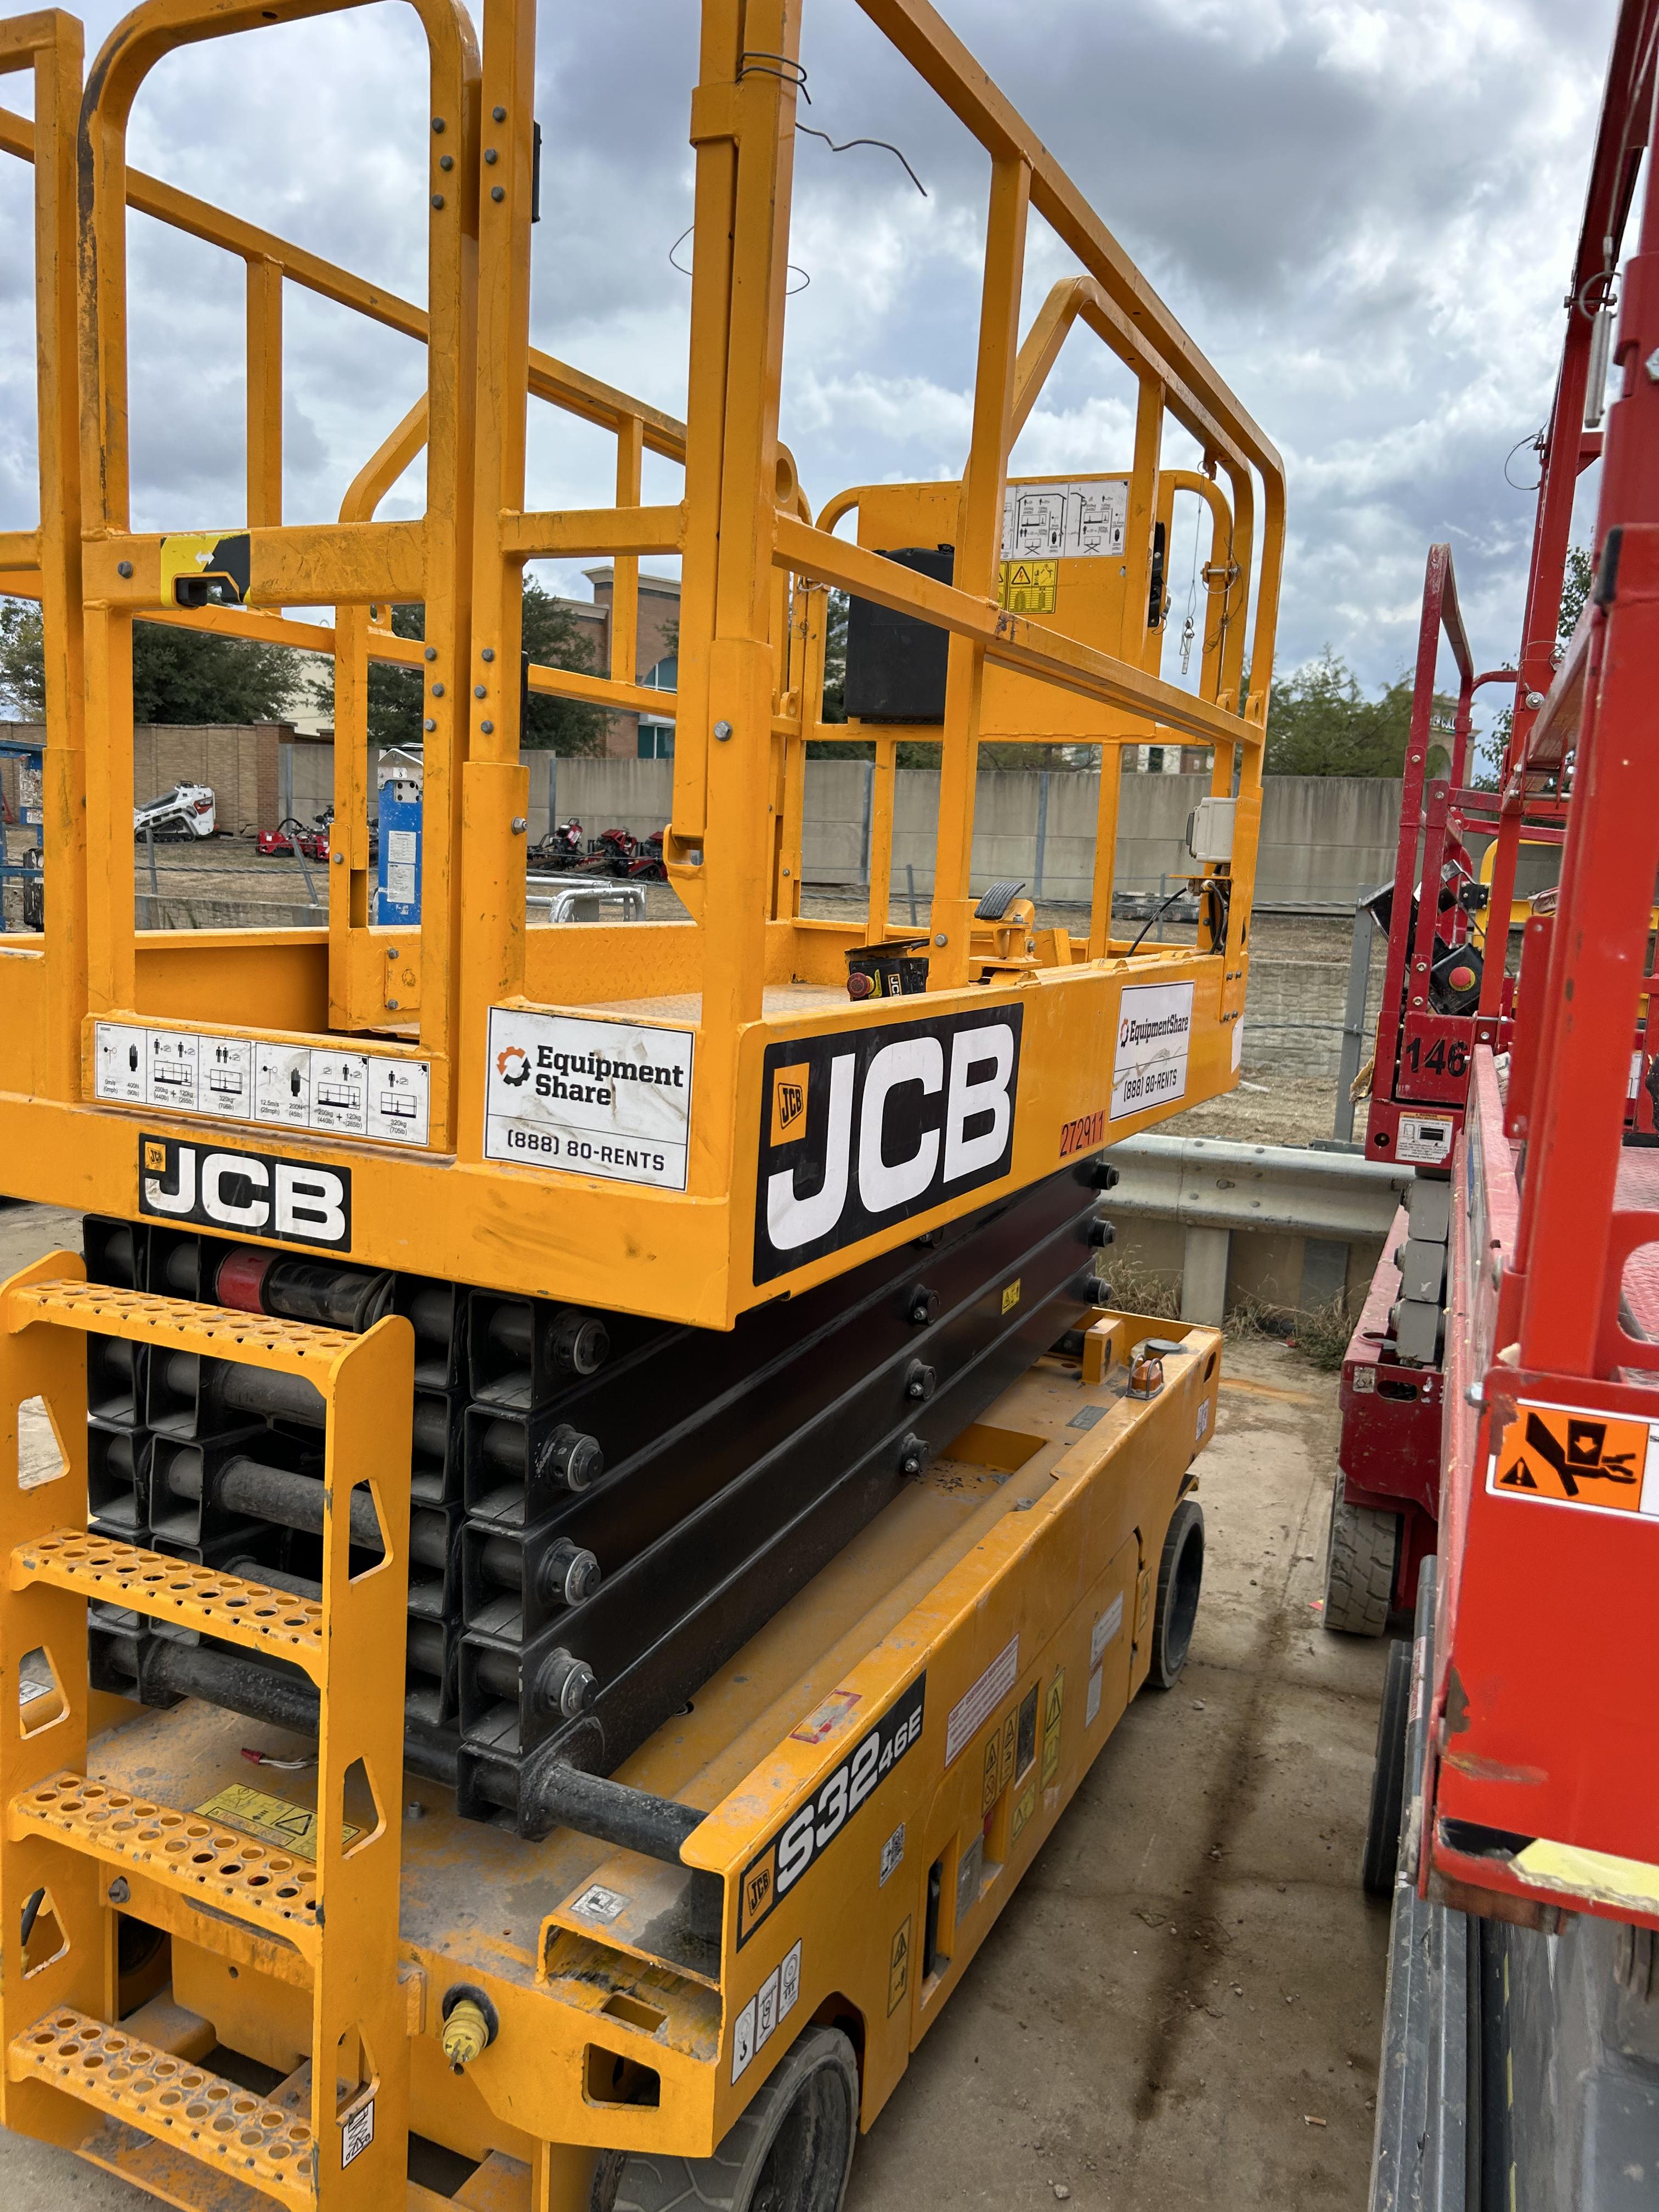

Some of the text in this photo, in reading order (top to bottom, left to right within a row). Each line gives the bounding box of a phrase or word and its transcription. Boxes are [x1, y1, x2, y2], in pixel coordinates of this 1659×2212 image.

[1129, 1014, 1189, 1046] EquipmentShare
[537, 1045, 684, 1087] Equipment
[1406, 1037, 1468, 1077] 146
[535, 1074, 611, 1105] Share
[781, 1087, 803, 1124] JCB
[1124, 1069, 1177, 1102] (888) 80-RENTS
[390, 1119, 407, 1128] 320kg
[768, 1024, 1014, 1250] JCB
[1059, 1110, 1104, 1157] 272911
[150, 1149, 162, 1162] JCB
[508, 1129, 664, 1171] (888) 80-RENTS
[145, 1147, 346, 1240] JCB
[777, 1704, 922, 1893] S32 46E
[751, 1870, 769, 1910] JCB
